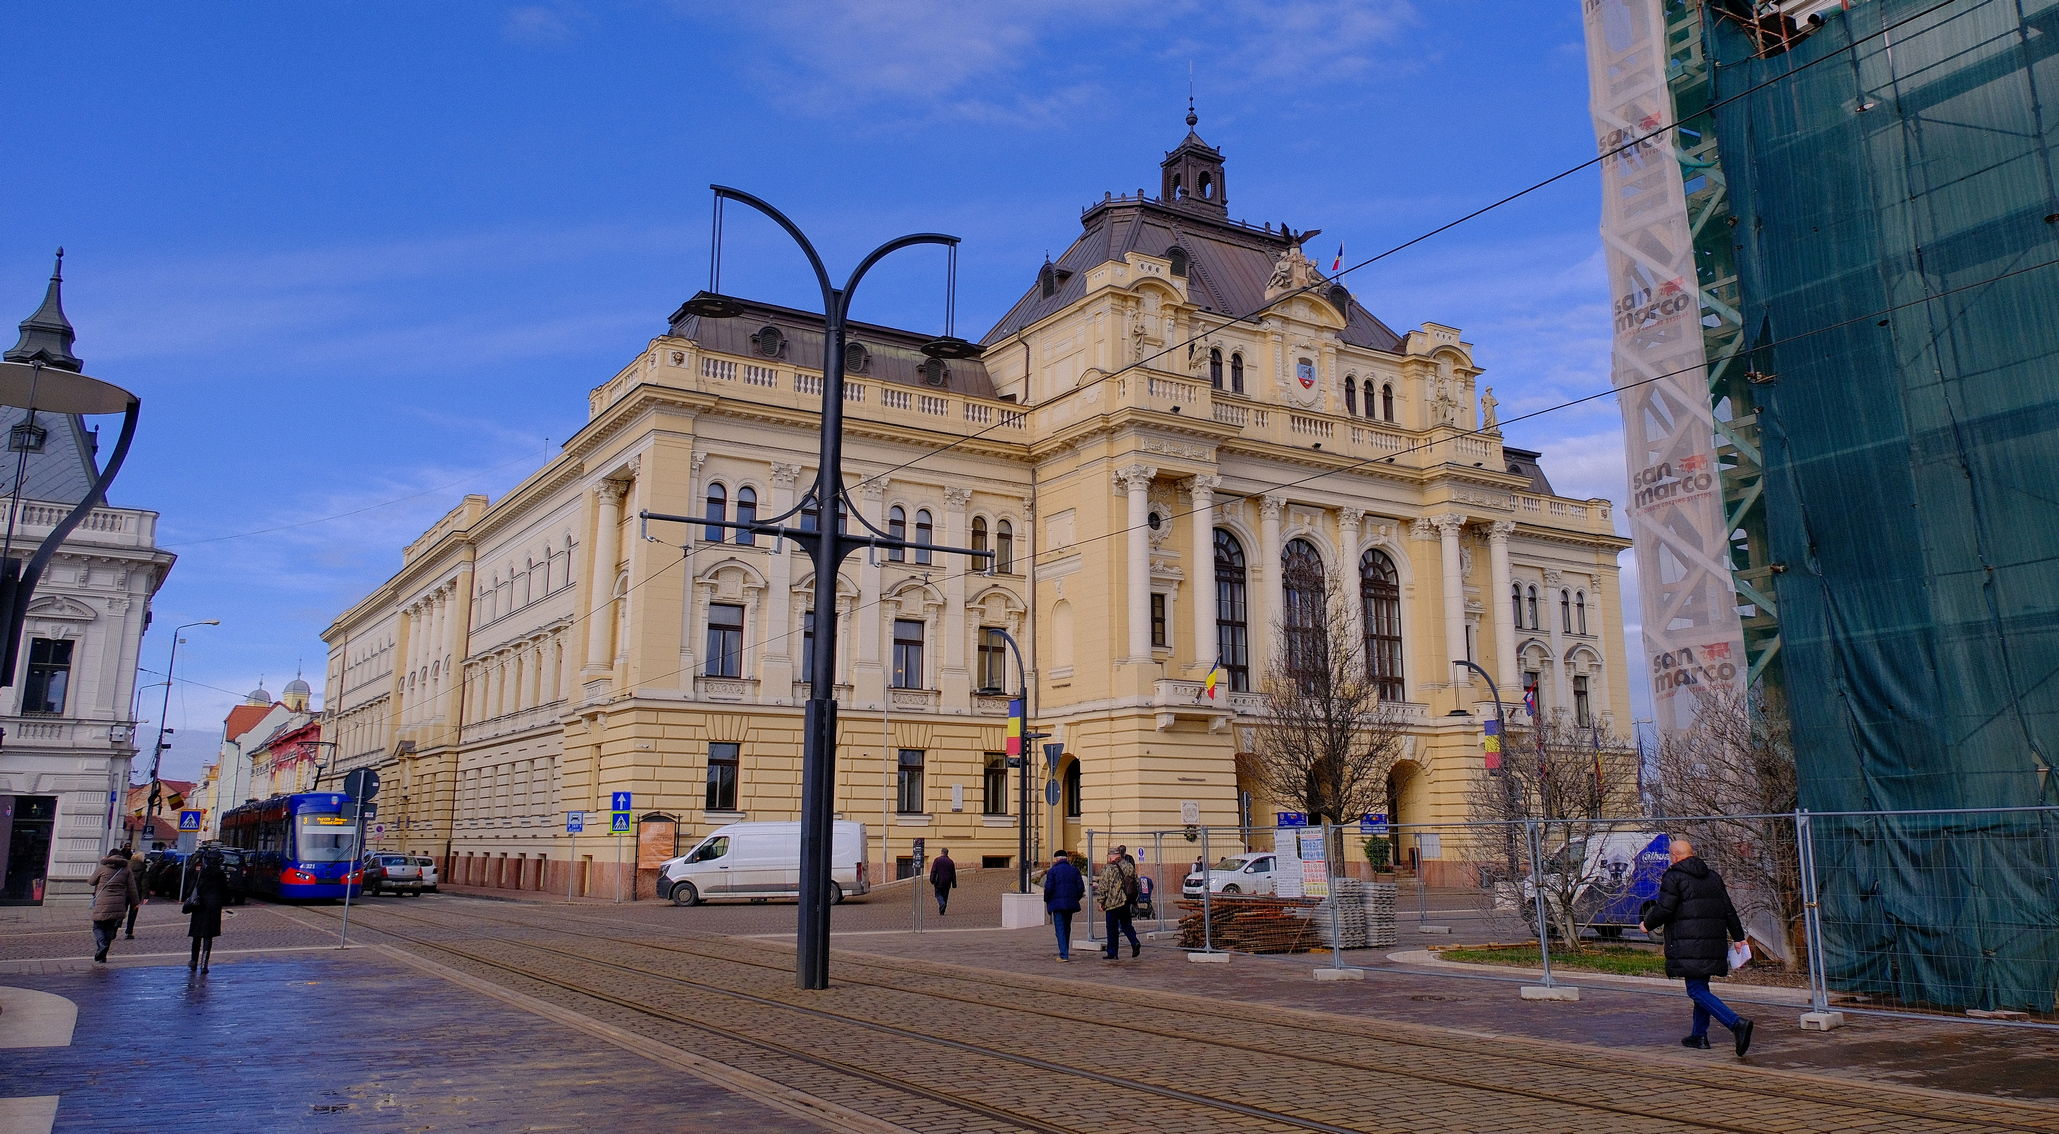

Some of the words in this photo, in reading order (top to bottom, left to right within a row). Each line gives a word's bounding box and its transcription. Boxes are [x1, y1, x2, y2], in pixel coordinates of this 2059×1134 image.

[1614, 287, 1652, 316] san
[1615, 294, 1690, 334] marco
[1633, 462, 1672, 490] san
[1634, 473, 1712, 509] marco
[1653, 647, 1693, 674] san
[1654, 662, 1737, 694] marco
